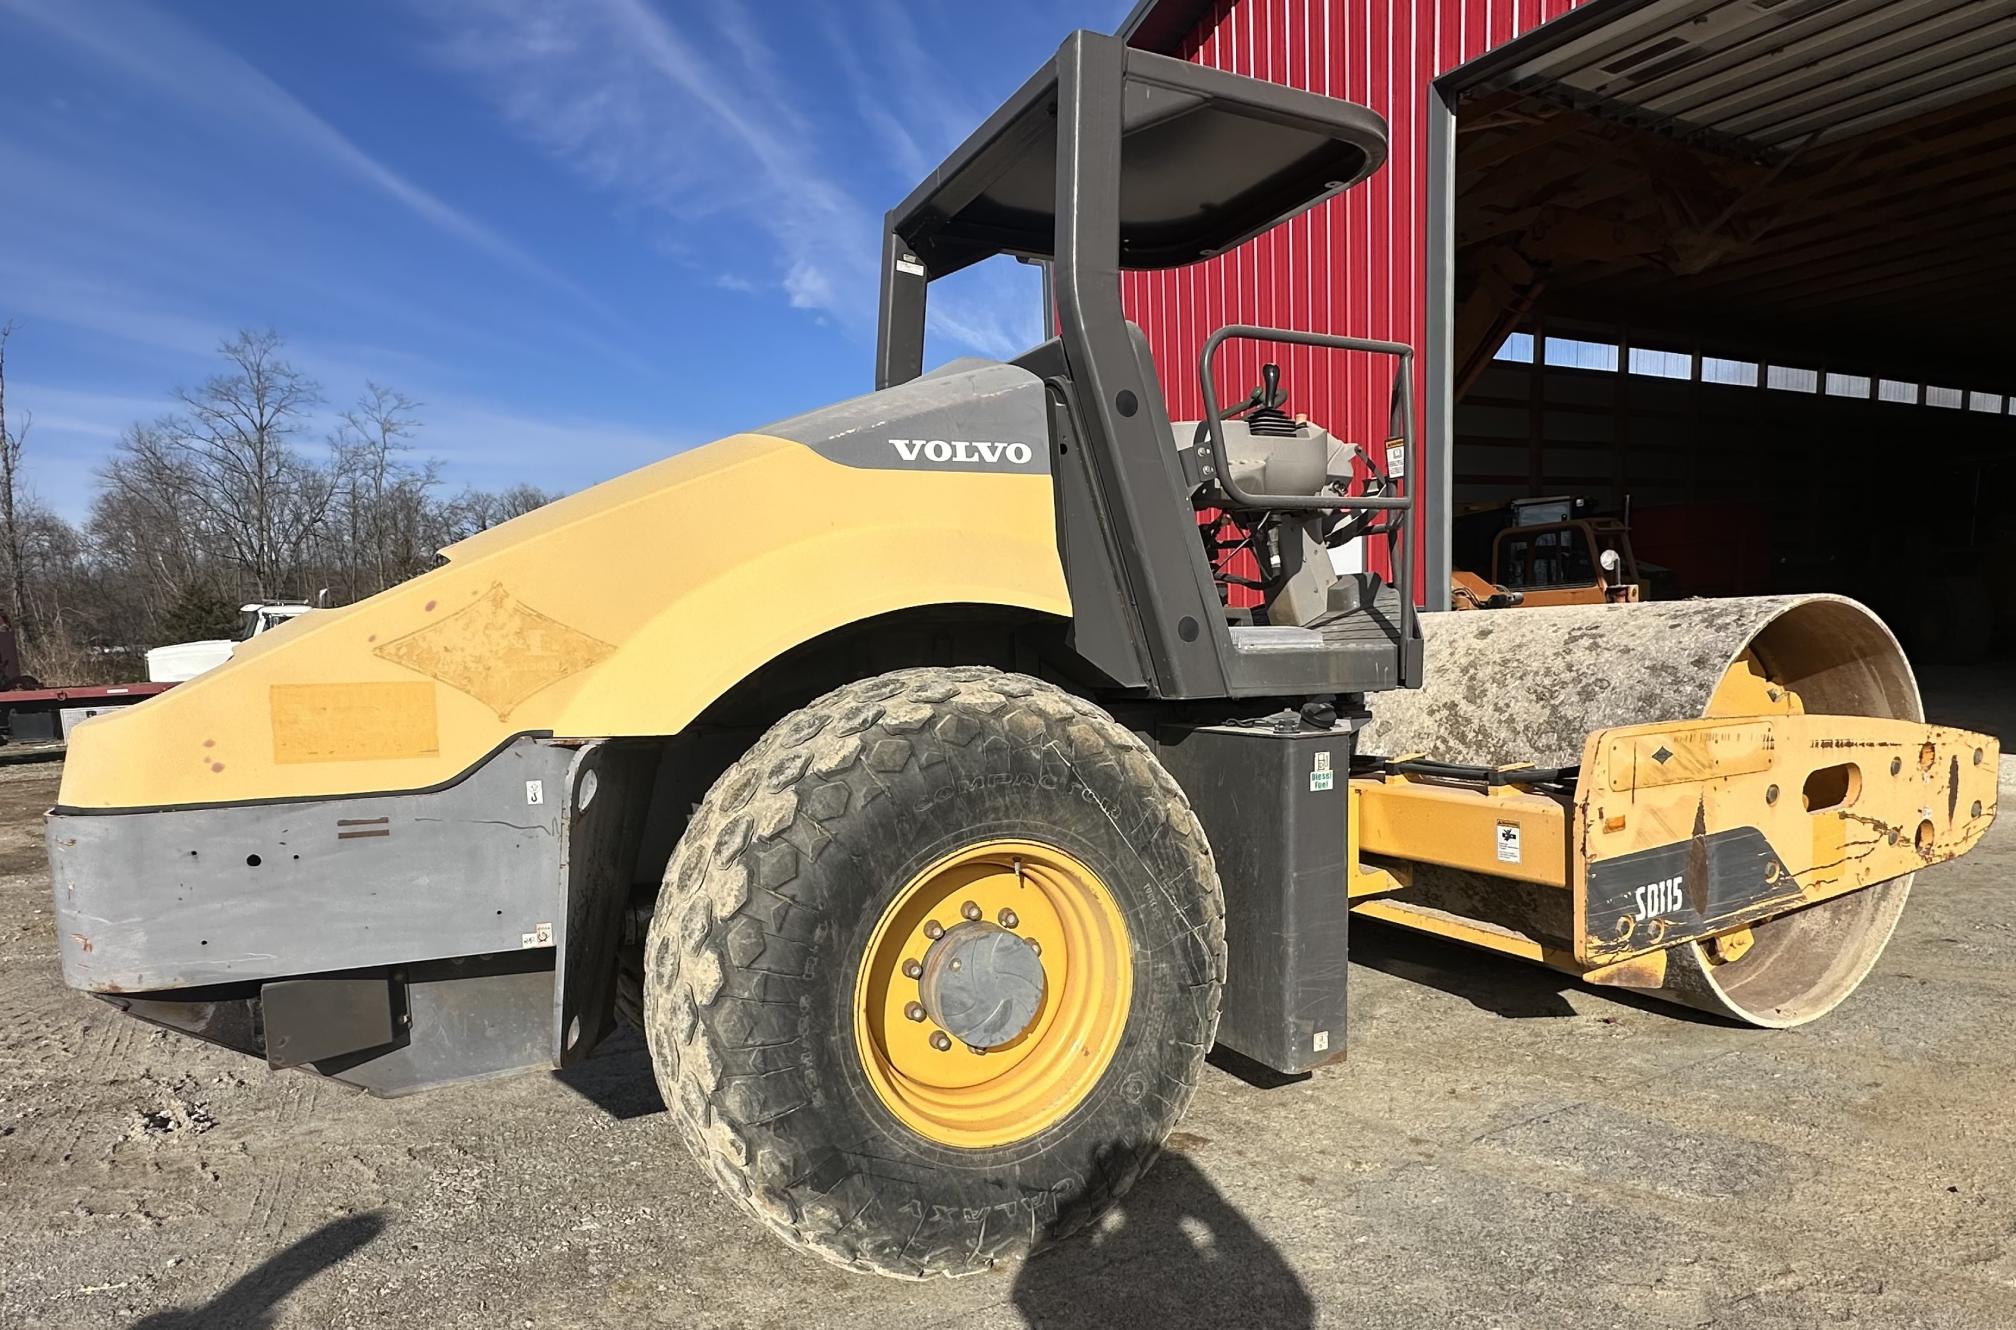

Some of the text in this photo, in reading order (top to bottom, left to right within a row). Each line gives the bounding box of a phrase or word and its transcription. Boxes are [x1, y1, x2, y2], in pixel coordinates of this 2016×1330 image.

[888, 439, 1032, 464] VOLVO
[1311, 772, 1332, 781] Diesel
[1314, 781, 1329, 789] fuel
[1635, 876, 1683, 922] SD115
